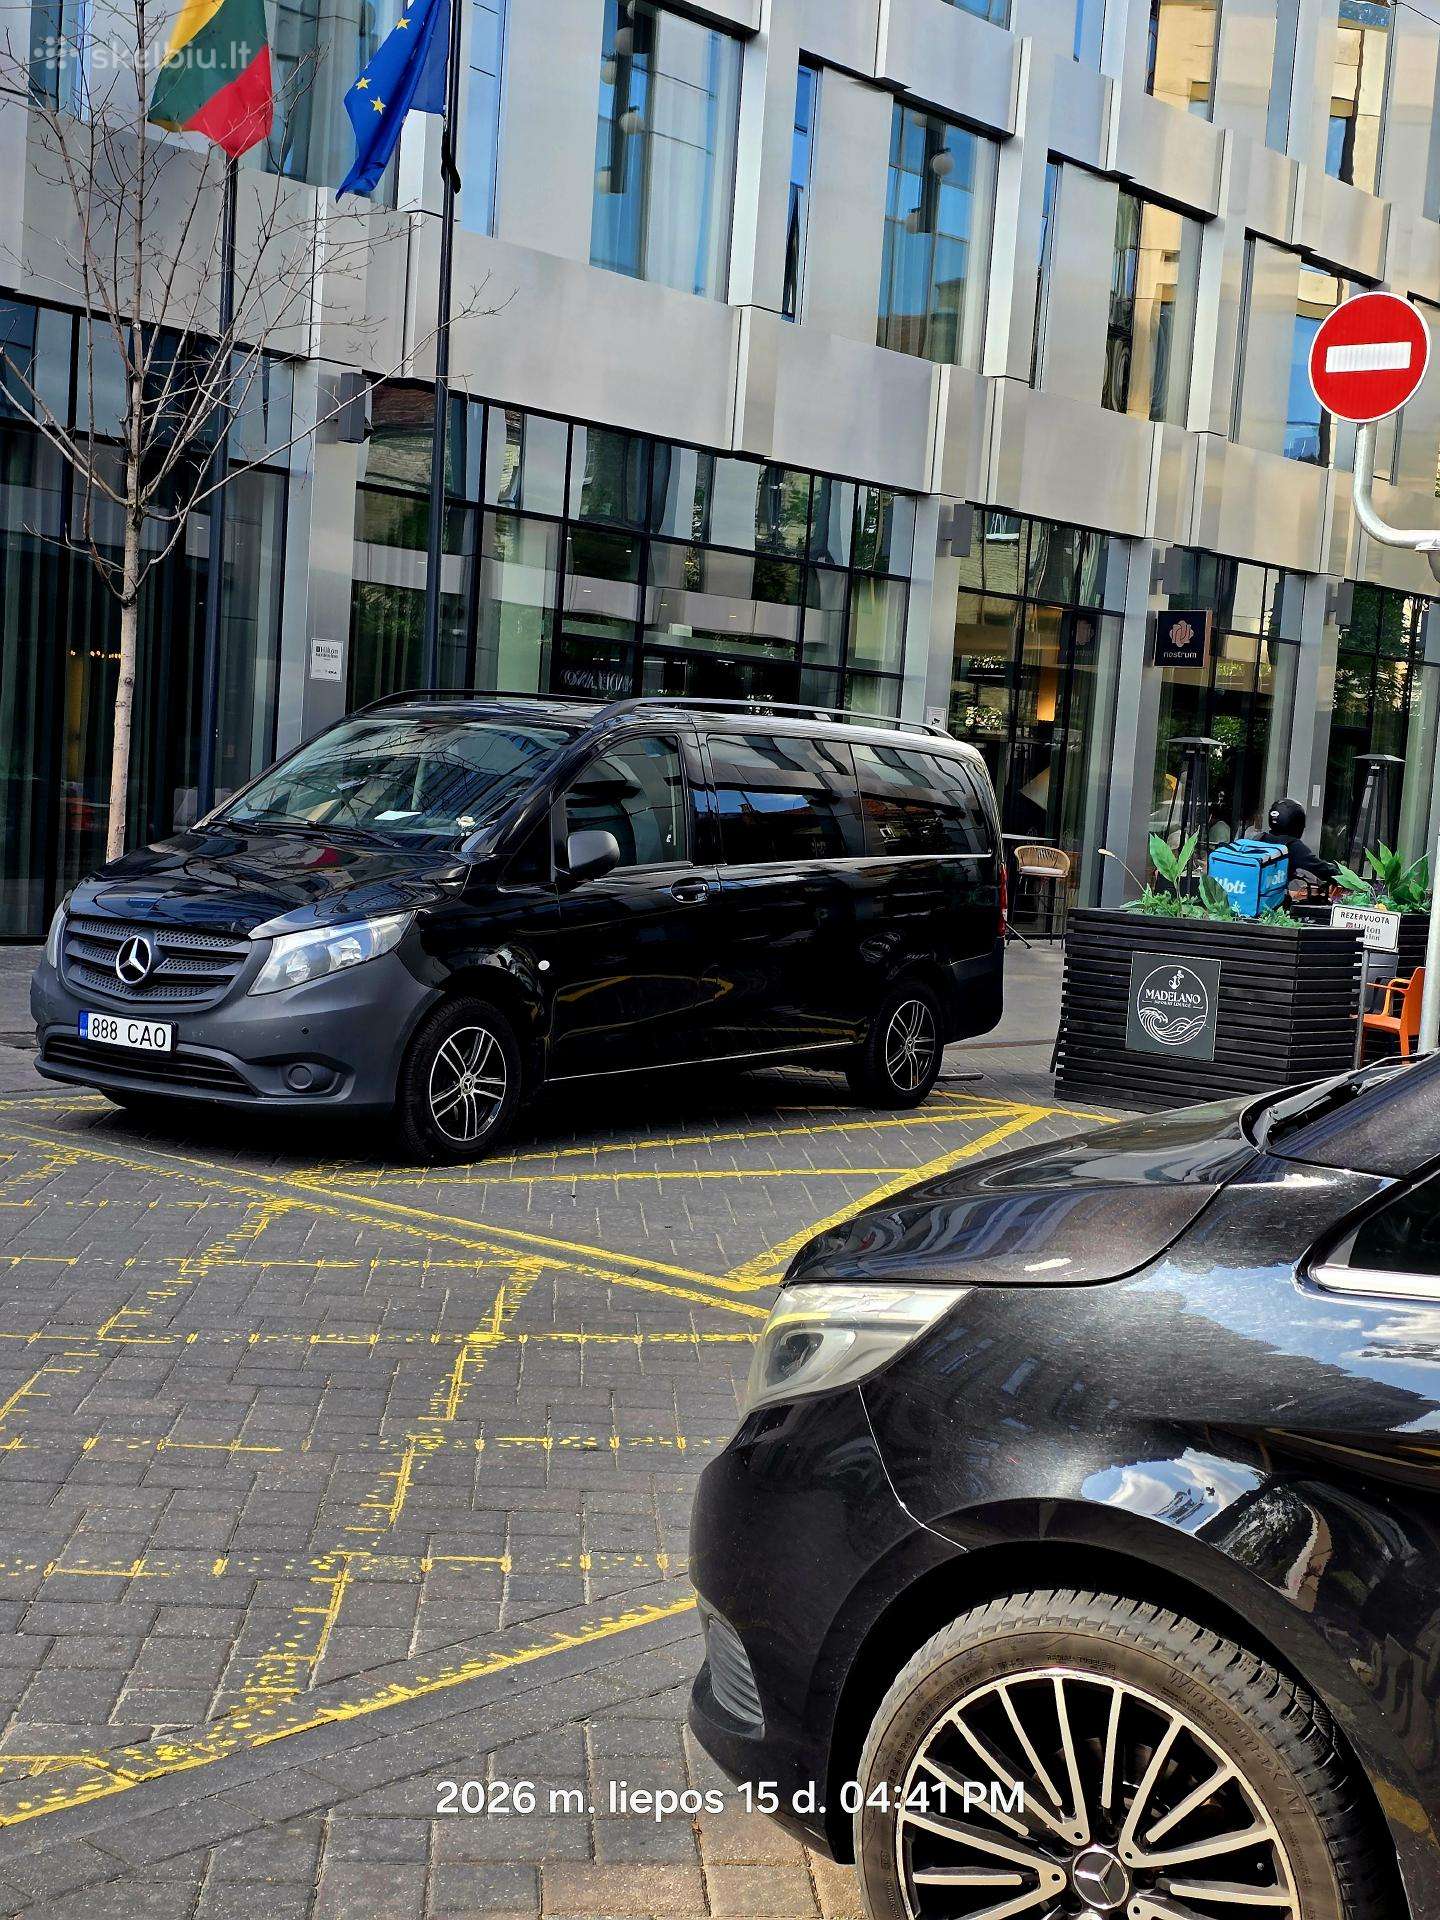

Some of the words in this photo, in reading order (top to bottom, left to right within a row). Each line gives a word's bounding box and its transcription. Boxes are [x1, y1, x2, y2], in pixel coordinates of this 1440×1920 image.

[1340, 911, 1390, 925] REZERVUOTA
[1145, 989, 1201, 1005] MADELANO
[92, 1018, 117, 1040] 888
[128, 1023, 166, 1047] CAO
